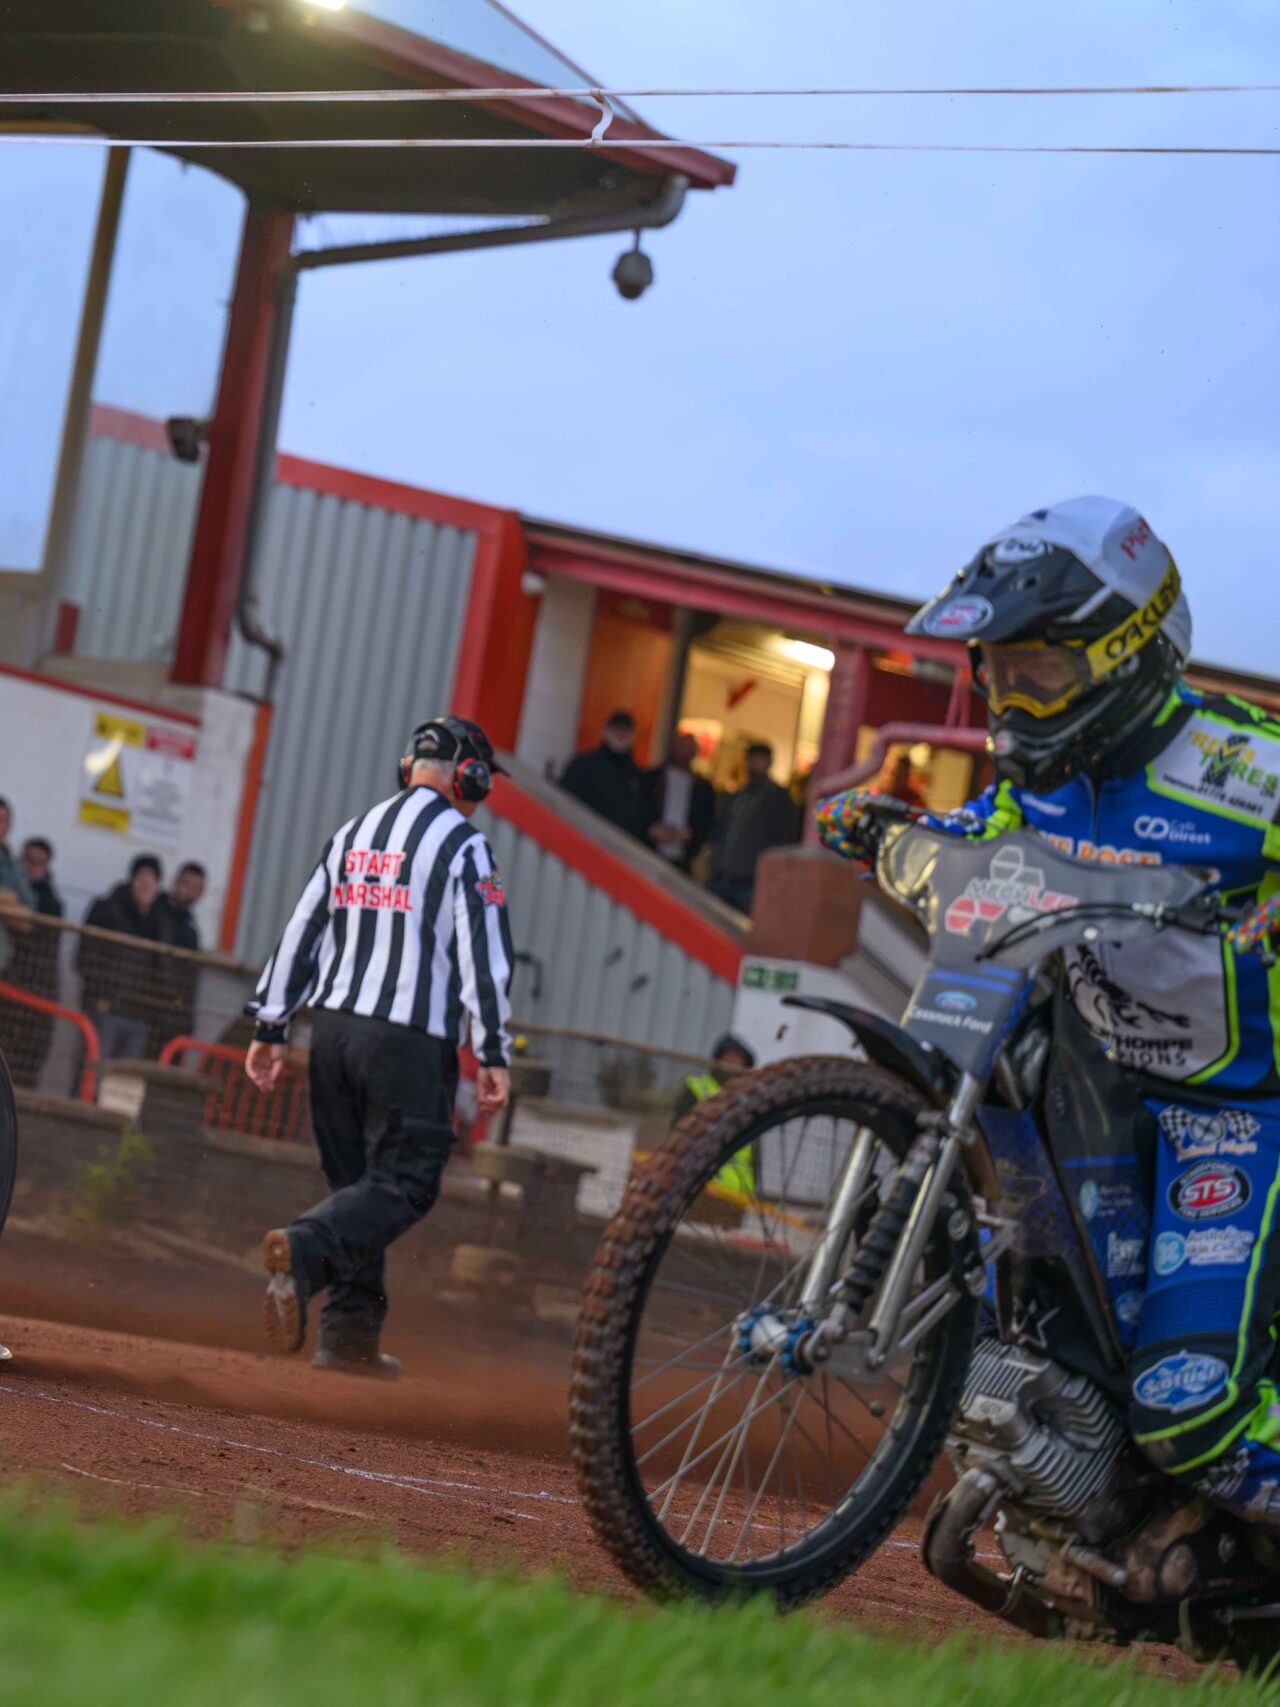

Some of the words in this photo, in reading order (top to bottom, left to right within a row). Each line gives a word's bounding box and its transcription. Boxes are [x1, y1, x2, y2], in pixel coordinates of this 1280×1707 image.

[1104, 578, 1179, 660] OAKLEY
[345, 850, 406, 876] START
[334, 881, 413, 912] MARSHAL
[962, 1015, 993, 1035] Ford
[1181, 1177, 1234, 1202] STS
